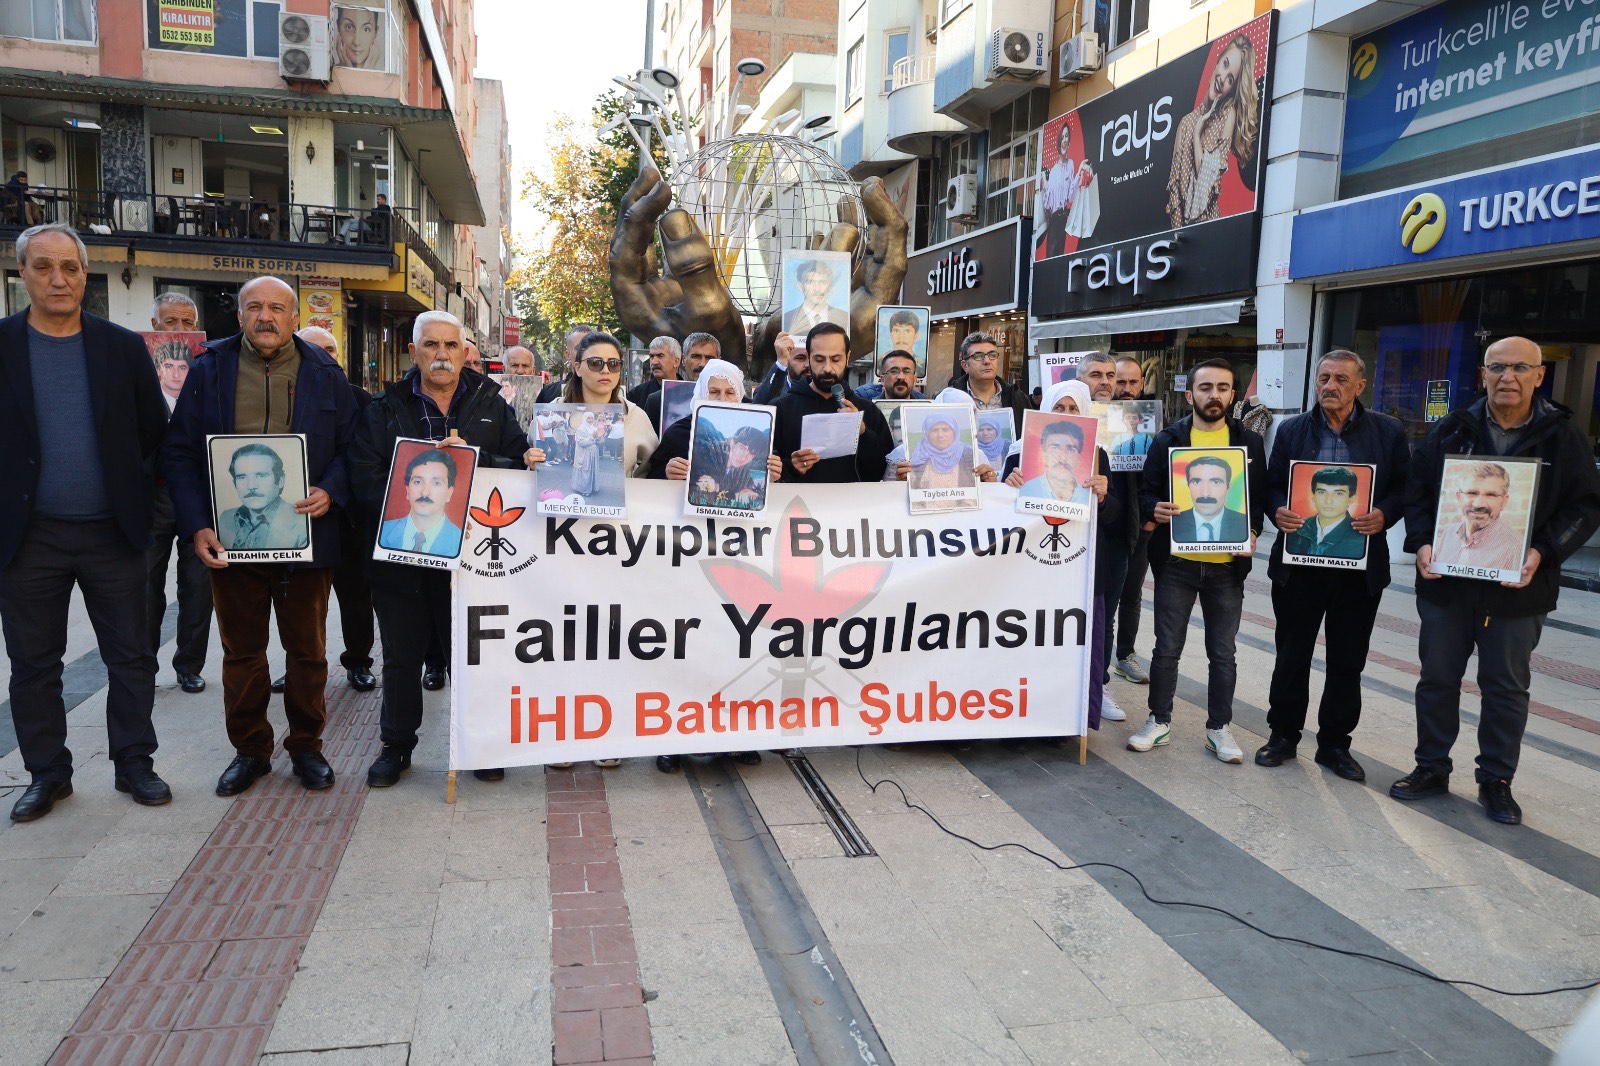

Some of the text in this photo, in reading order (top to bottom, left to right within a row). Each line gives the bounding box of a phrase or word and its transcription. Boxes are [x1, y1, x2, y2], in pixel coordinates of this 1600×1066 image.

[162, 29, 179, 40] 0532
[180, 31, 192, 42] 553
[194, 32, 202, 42] 58
[1401, 1, 1529, 70] Turkcell'le
[1036, 32, 1044, 66] BEKO
[1394, 50, 1507, 113] internet
[1099, 95, 1173, 163] rays
[258, 260, 318, 273] SOFRASI
[926, 246, 978, 296] stilife
[1067, 239, 1173, 296] rays
[300, 279, 340, 287] SOFRASI
[1045, 356, 1066, 366] EDİP
[923, 489, 965, 499] Taybet Ana
[544, 503, 622, 516] MERYEM BULUT
[1024, 501, 1044, 510] Eset
[696, 506, 755, 519] İSMAİL AĞAYA
[545, 516, 1027, 568] Kayıplar Bulunsun
[227, 550, 303, 561] İBRAHİM ÇELİK
[417, 557, 448, 568] SEVEN
[460, 553, 539, 578] SAN HAKLARI DERNEĞİ
[487, 561, 504, 570] 1986
[1327, 559, 1358, 567] MALTU
[1446, 564, 1500, 579] TAHİR ELÇİ
[466, 601, 1086, 670] Failler Yargılansın
[510, 676, 1029, 744] İHD Batman Şubesi
